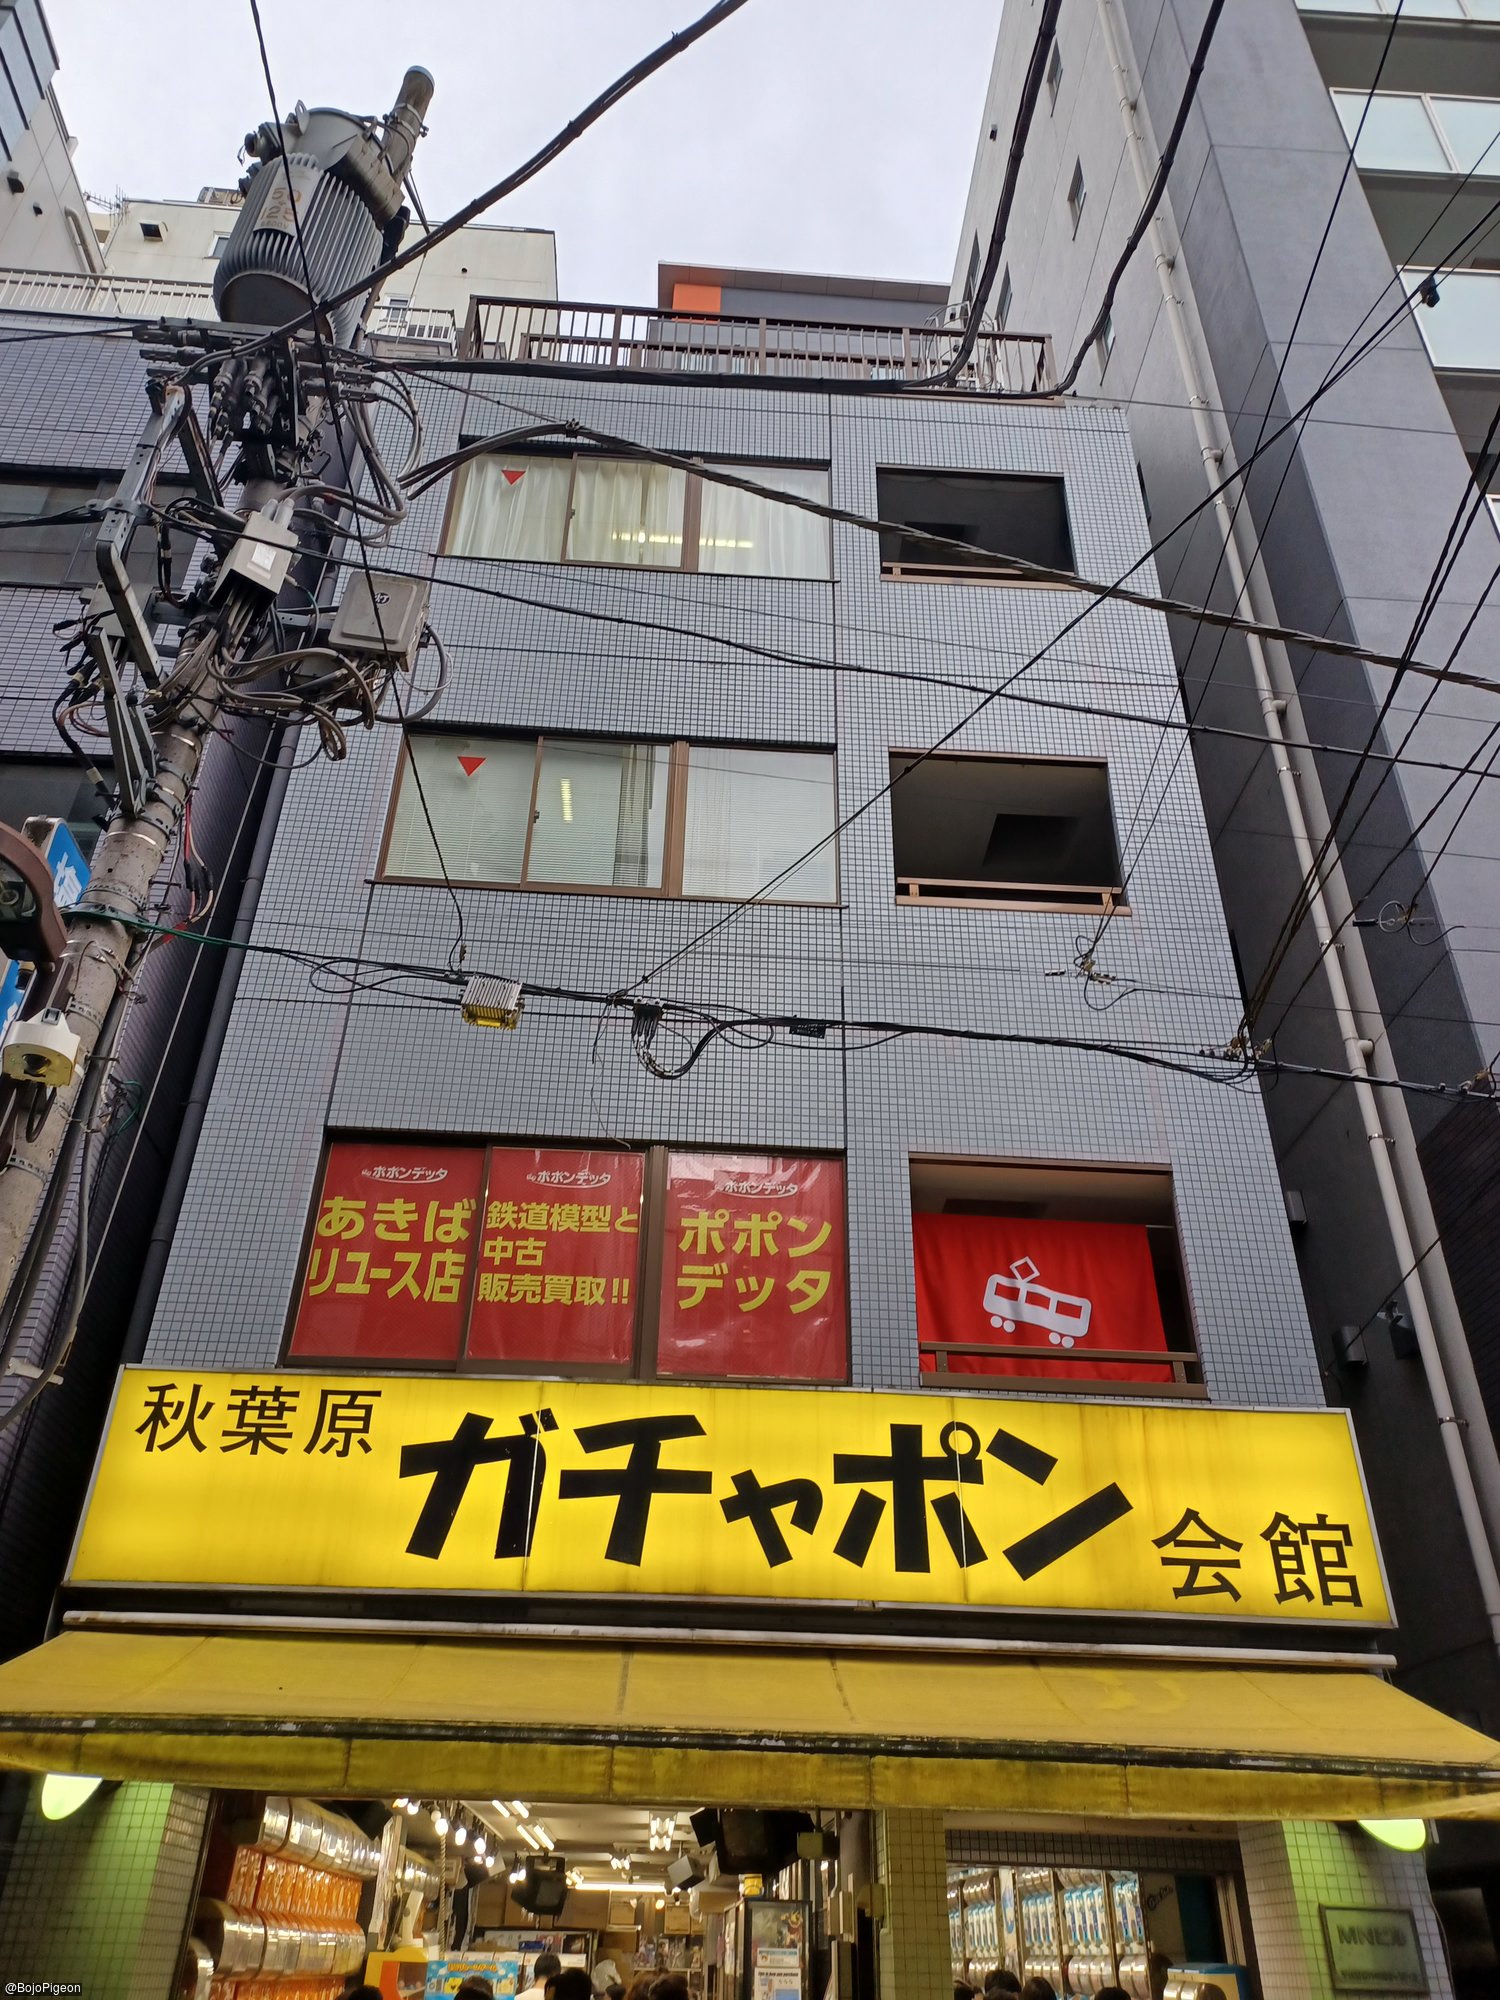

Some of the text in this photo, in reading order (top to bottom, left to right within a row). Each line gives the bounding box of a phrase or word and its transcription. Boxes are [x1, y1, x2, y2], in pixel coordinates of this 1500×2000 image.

[372, 1165, 449, 1181] ポポンデッタ
[537, 1169, 612, 1186] ポポンデッタ
[315, 1197, 473, 1243] あきば
[486, 1202, 639, 1234] 鉄道模型と
[680, 1210, 833, 1257] ポポン
[484, 1237, 547, 1266] 中古
[308, 1247, 466, 1304] リユース店
[678, 1263, 832, 1313] デッタ
[135, 1383, 1363, 1608] 秋葉原 ガチャポン 会館
